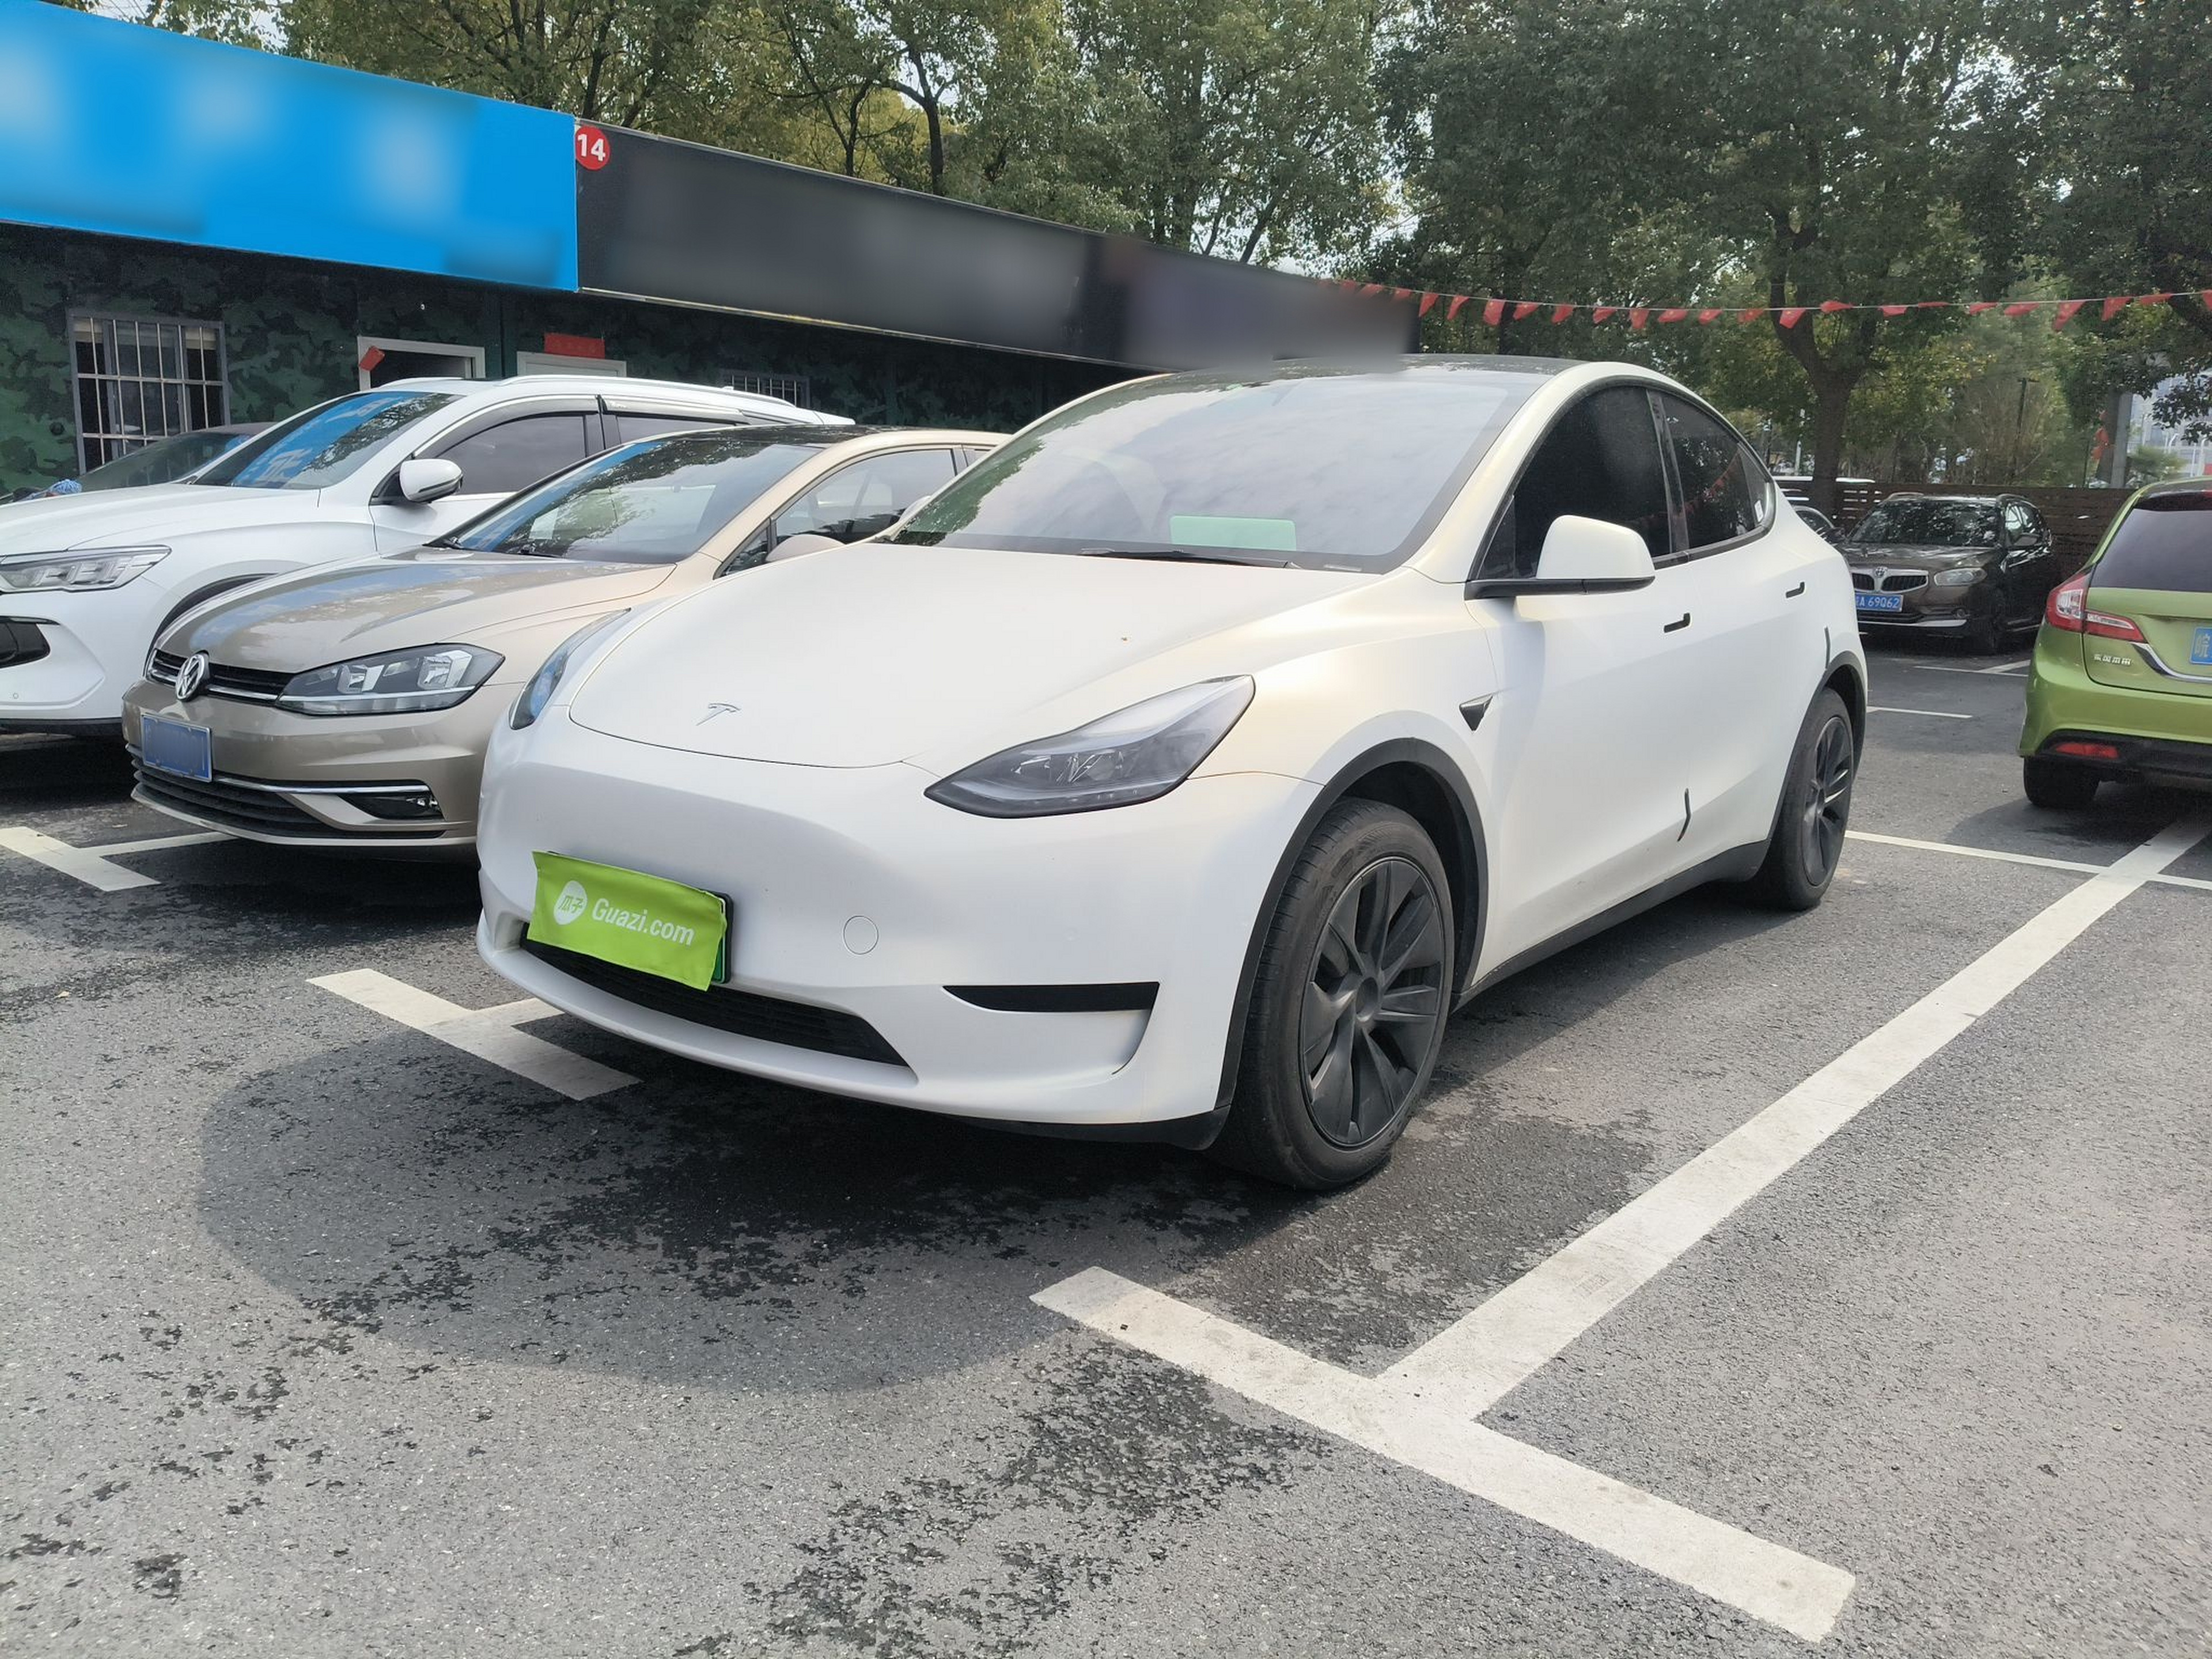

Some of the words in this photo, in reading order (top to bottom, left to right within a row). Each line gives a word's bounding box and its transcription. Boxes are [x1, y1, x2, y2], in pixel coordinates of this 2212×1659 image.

[577, 134, 606, 162] 14
[558, 895, 584, 914] 瓜子
[592, 897, 695, 946] Guazi.com
